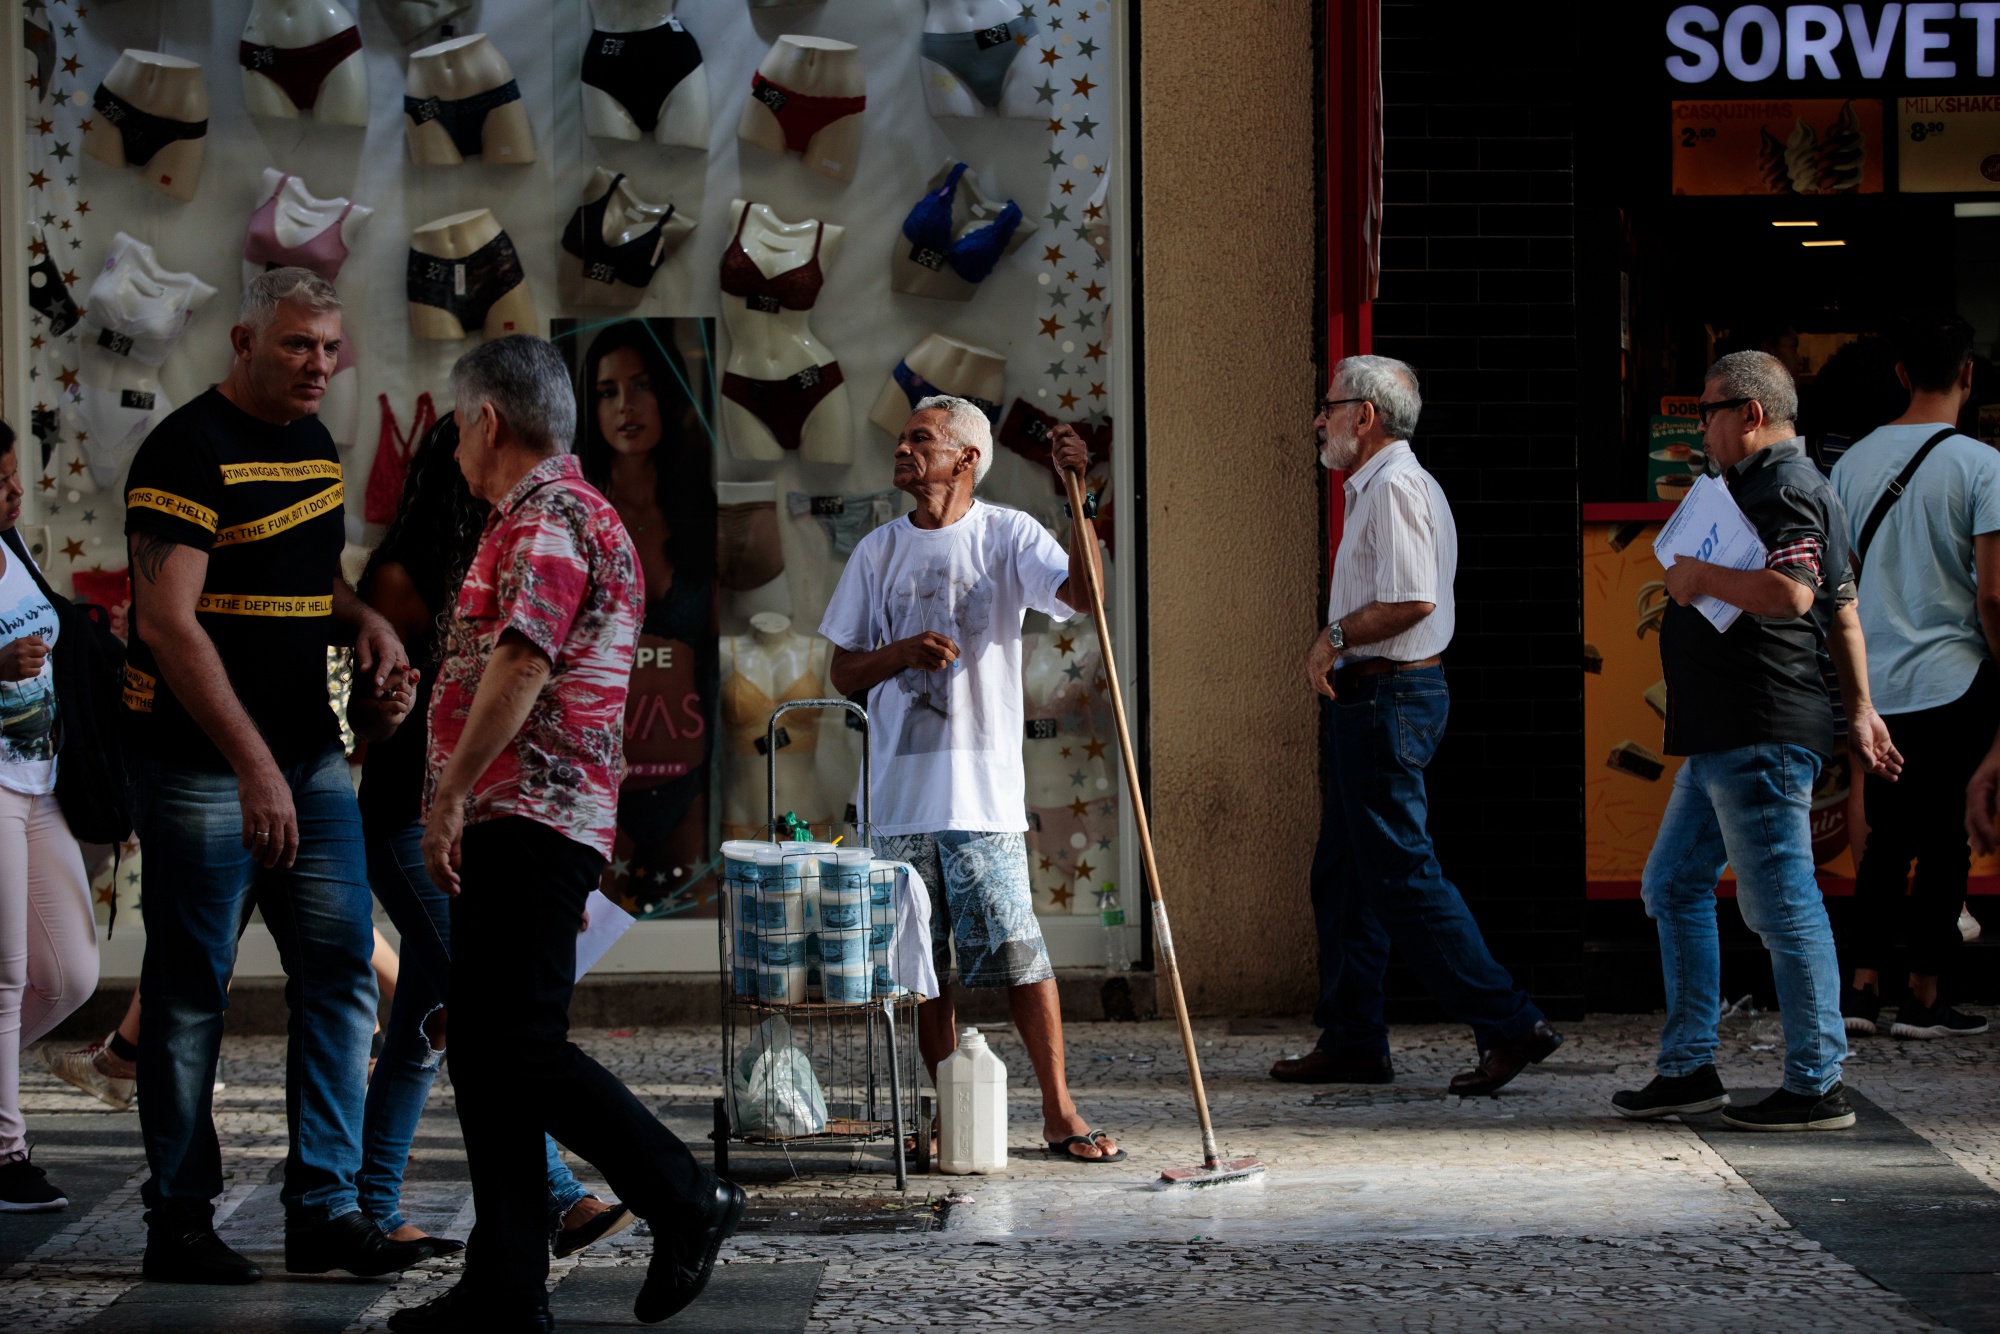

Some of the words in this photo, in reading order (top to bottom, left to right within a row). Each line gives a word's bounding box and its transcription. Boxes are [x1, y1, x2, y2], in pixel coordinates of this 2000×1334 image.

[1665, 3, 2000, 83] SORVET
[1676, 104, 1793, 122] CASQUINHAS
[249, 467, 280, 476] NIGGAS
[281, 465, 309, 476] TRYING
[310, 464, 320, 474] TO
[156, 496, 174, 508] OF
[177, 502, 208, 524] HELL
[238, 524, 266, 539] THE
[292, 508, 303, 521] BUT
[214, 598, 240, 610] THE
[244, 600, 292, 612] DEPTHS
[295, 601, 306, 612] OF
[309, 601, 328, 611] HELL
